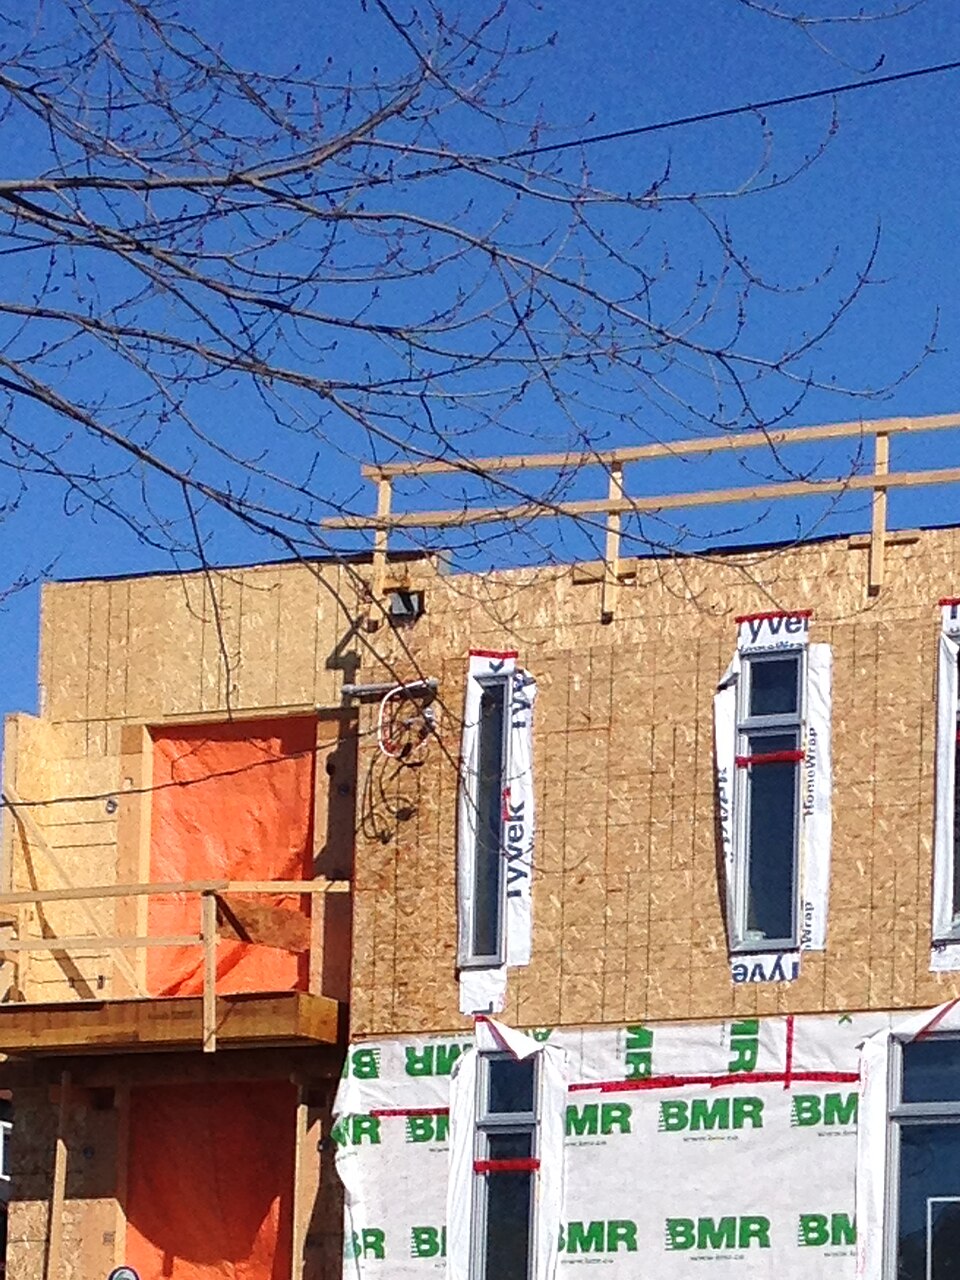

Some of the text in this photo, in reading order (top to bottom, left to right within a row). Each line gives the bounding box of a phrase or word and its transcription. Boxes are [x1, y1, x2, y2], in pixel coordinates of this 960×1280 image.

[566, 1093, 859, 1136] MR BMR BM
[664, 1215, 771, 1251] BMR
[798, 1212, 857, 1247] BM
